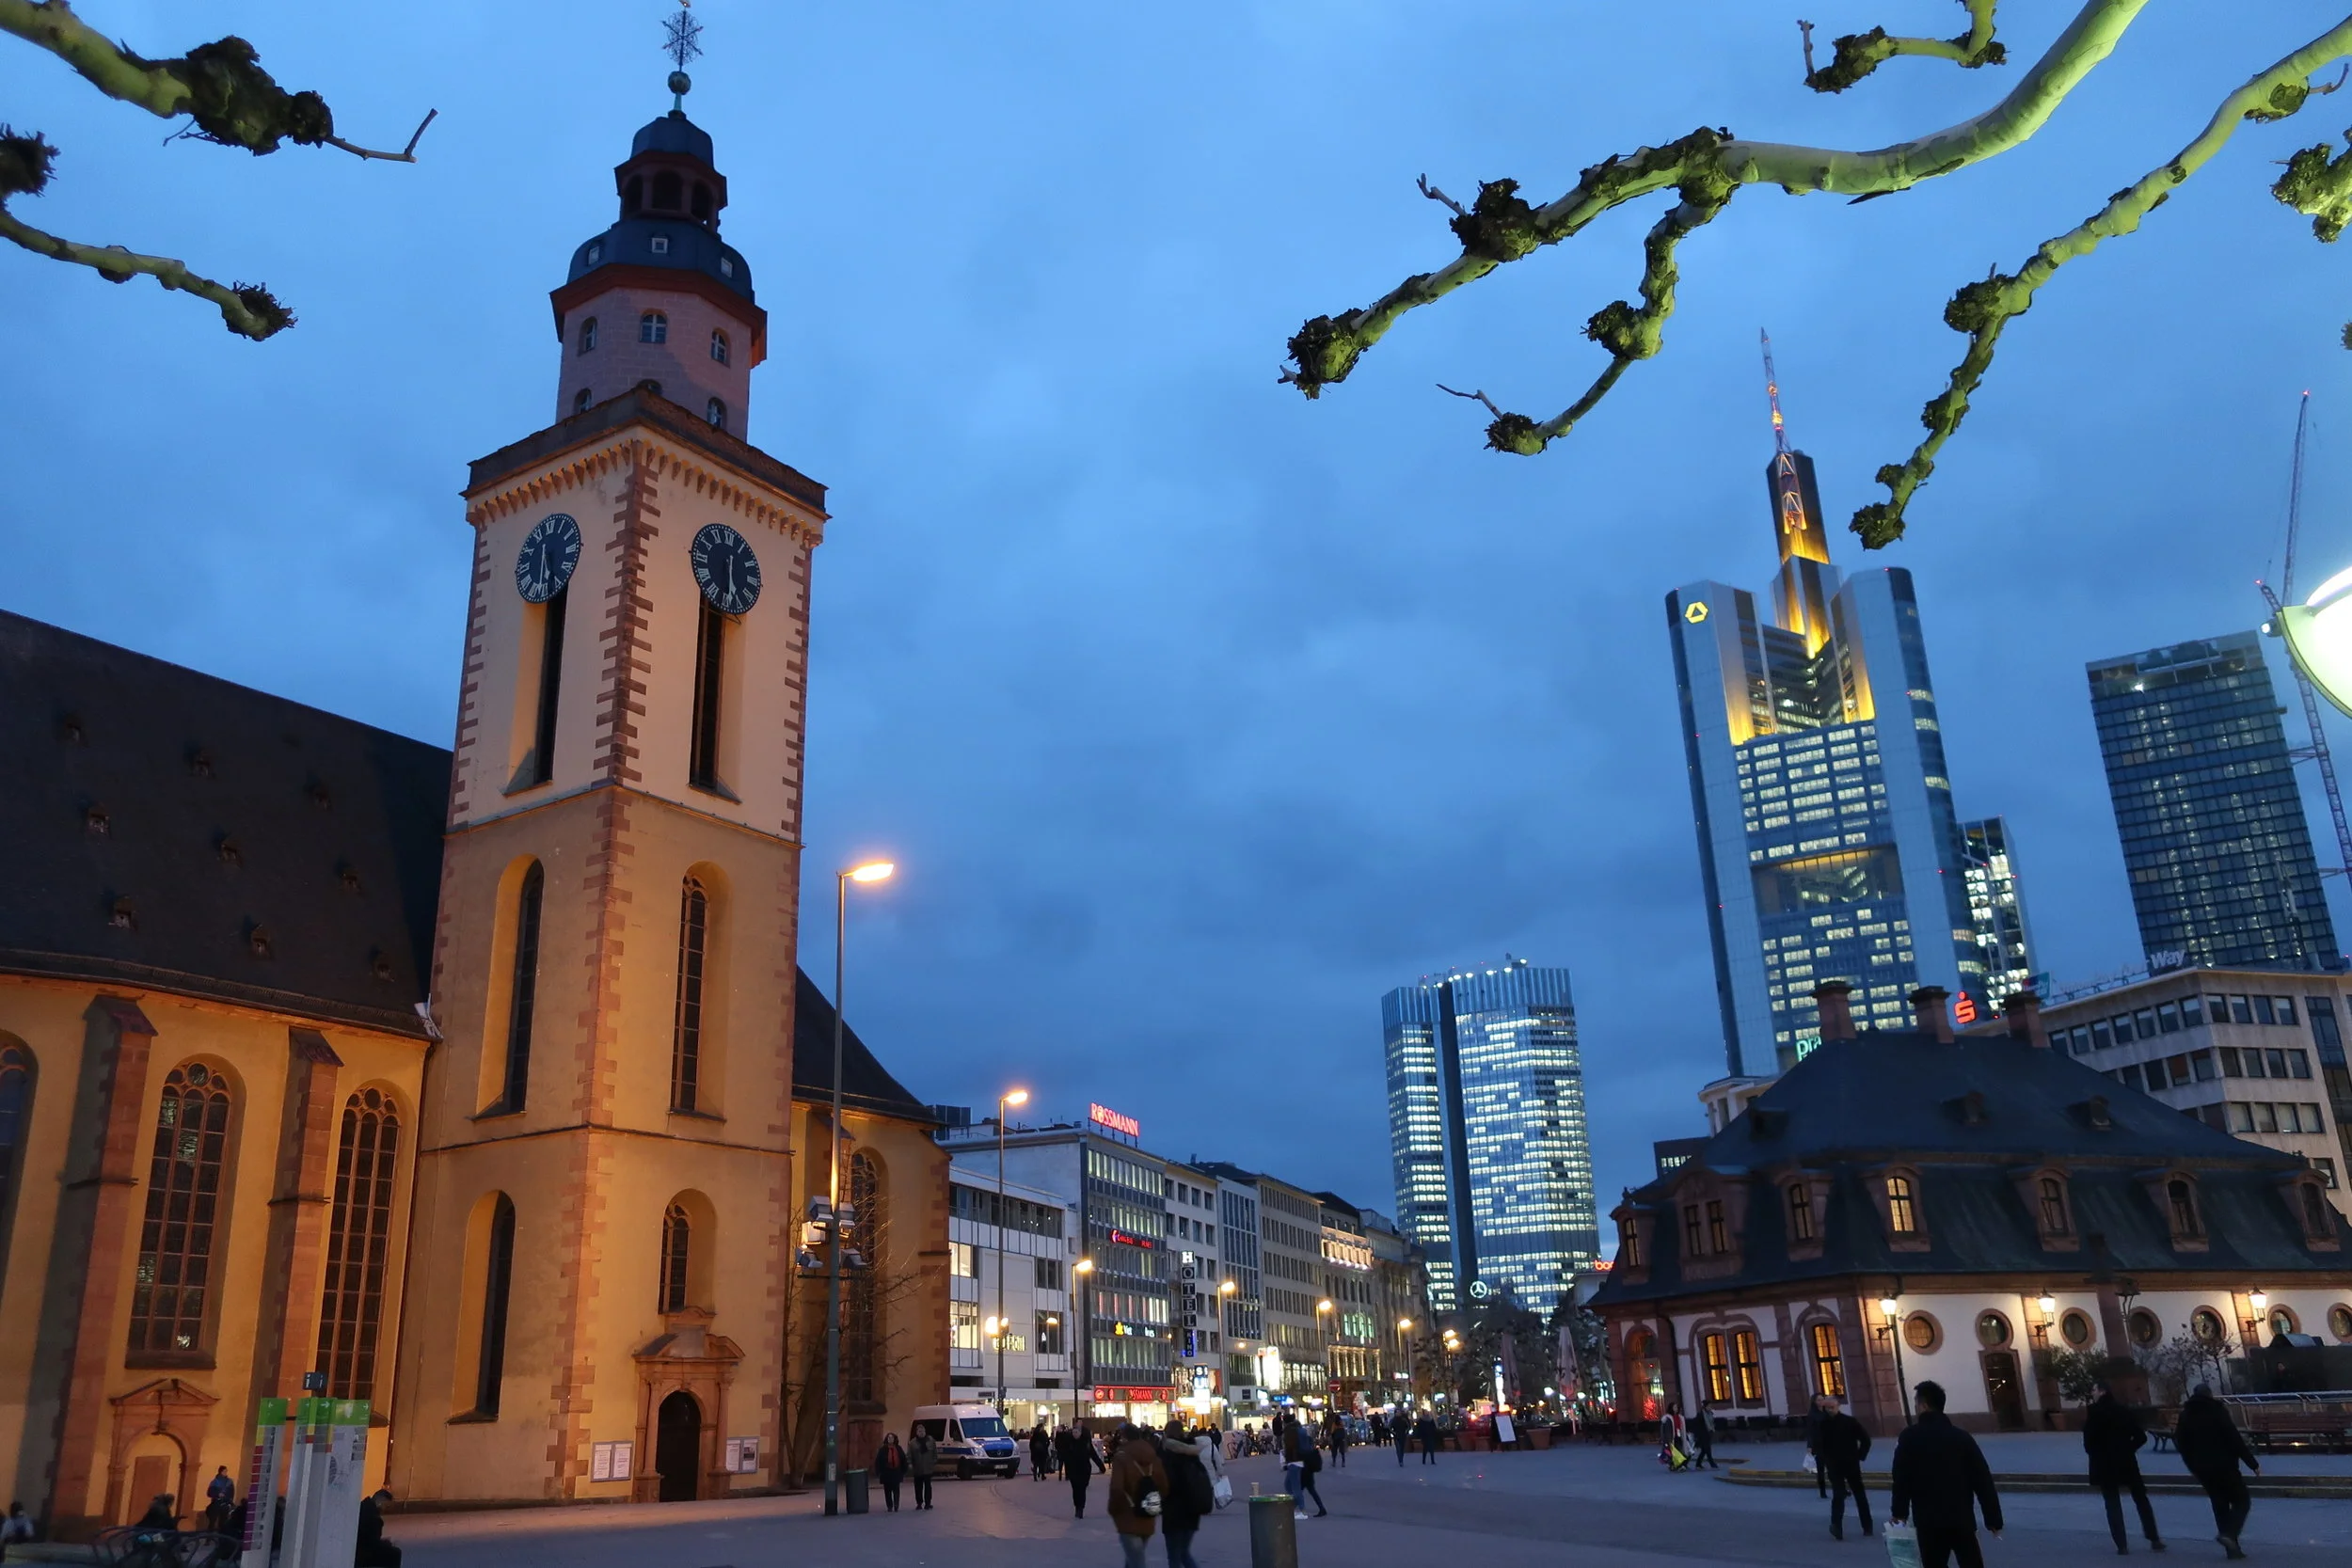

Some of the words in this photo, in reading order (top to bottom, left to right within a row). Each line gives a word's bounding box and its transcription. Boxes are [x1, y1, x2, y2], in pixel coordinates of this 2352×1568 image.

[2150, 948, 2185, 970] Way
[1091, 1101, 1138, 1137] ROSSMANN
[1181, 1249, 1196, 1327] HOTEL
